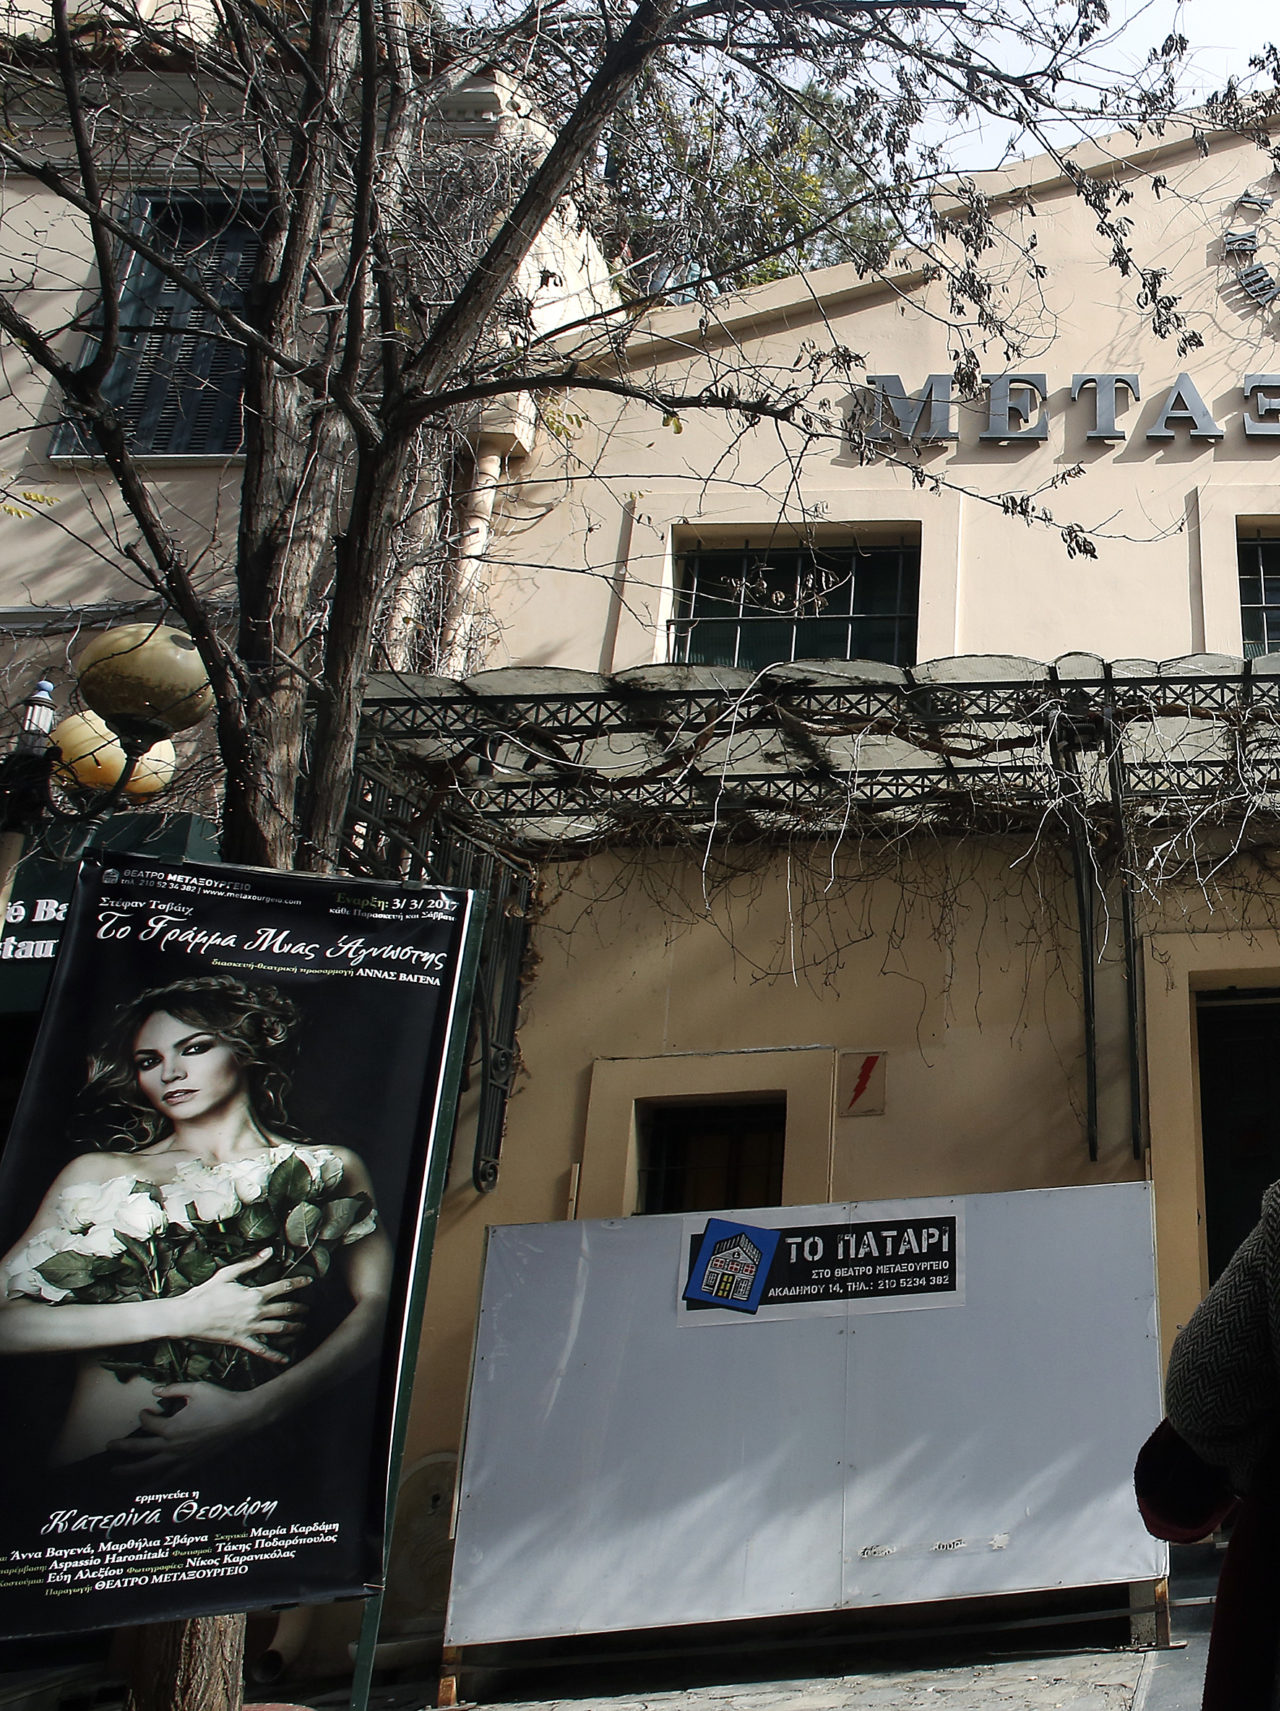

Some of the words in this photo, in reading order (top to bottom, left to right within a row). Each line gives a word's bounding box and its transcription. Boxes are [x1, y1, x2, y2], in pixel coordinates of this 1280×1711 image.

[123, 869, 165, 881] ΘΕΑΤΡΟ
[166, 873, 252, 891] ΜΕΤΑΞΟΥΡΓΕΙΟ
[98, 896, 147, 911] Στέφαν
[148, 899, 195, 916] Τσβάιχ
[156, 881, 168, 889] 52
[168, 882, 180, 890] 34
[180, 884, 196, 893] 382
[202, 888, 302, 906] www.metaxourgeio.com
[96, 911, 135, 940] Το
[138, 914, 239, 955] Γράμμα
[243, 927, 320, 961] Μιας
[325, 934, 448, 971] Άγνωστης
[355, 967, 398, 981] ΑΝΝΑΣ
[398, 971, 441, 987] ΒΑΓΕΝΑ
[785, 1235, 824, 1264] ΤΟ
[836, 1226, 950, 1260] ΠΑΤΑΡΙ
[811, 1267, 831, 1280] ΣΤΟ
[834, 1264, 873, 1278] ΘΕΑΤΡΟ
[875, 1260, 950, 1276] ΜΕΤΑΞΟΥΡΓΕΙΟ
[768, 1284, 826, 1298] ΑΚΑΔΗΜΟΥ
[877, 1278, 897, 1290] 210
[900, 1276, 927, 1288] 5234
[929, 1274, 950, 1285] 382
[135, 1489, 189, 1505] ερμηνεύει
[192, 1489, 200, 1500] η
[40, 1507, 162, 1540] Κατερίνα
[172, 1496, 279, 1527] Θεοχάρη
[0, 1564, 48, 1576] αρέμβαση:
[48, 1555, 102, 1572] Aspassio
[104, 1547, 170, 1565] Haronitaki
[215, 1541, 252, 1554] Τάκης
[254, 1532, 339, 1550] Ποδαρόπουλος
[10, 1550, 43, 1561] Άννα
[45, 1543, 95, 1558] Βαγενά,
[97, 1538, 162, 1554] Μαρθήλια
[163, 1533, 209, 1548] Σβάρνα
[249, 1525, 288, 1539] Μαρία
[289, 1521, 340, 1536] Καρδάμη
[46, 1571, 72, 1584] Εύη
[73, 1567, 124, 1582] Αλεξίου
[185, 1556, 221, 1569] Νίκος
[222, 1548, 297, 1565] Καρανικόλας
[94, 1575, 149, 1591] ΘΕΑΤΡΟ
[150, 1563, 250, 1585] ΜΕΤΑΞΟΥΡΓΕΙΟ
